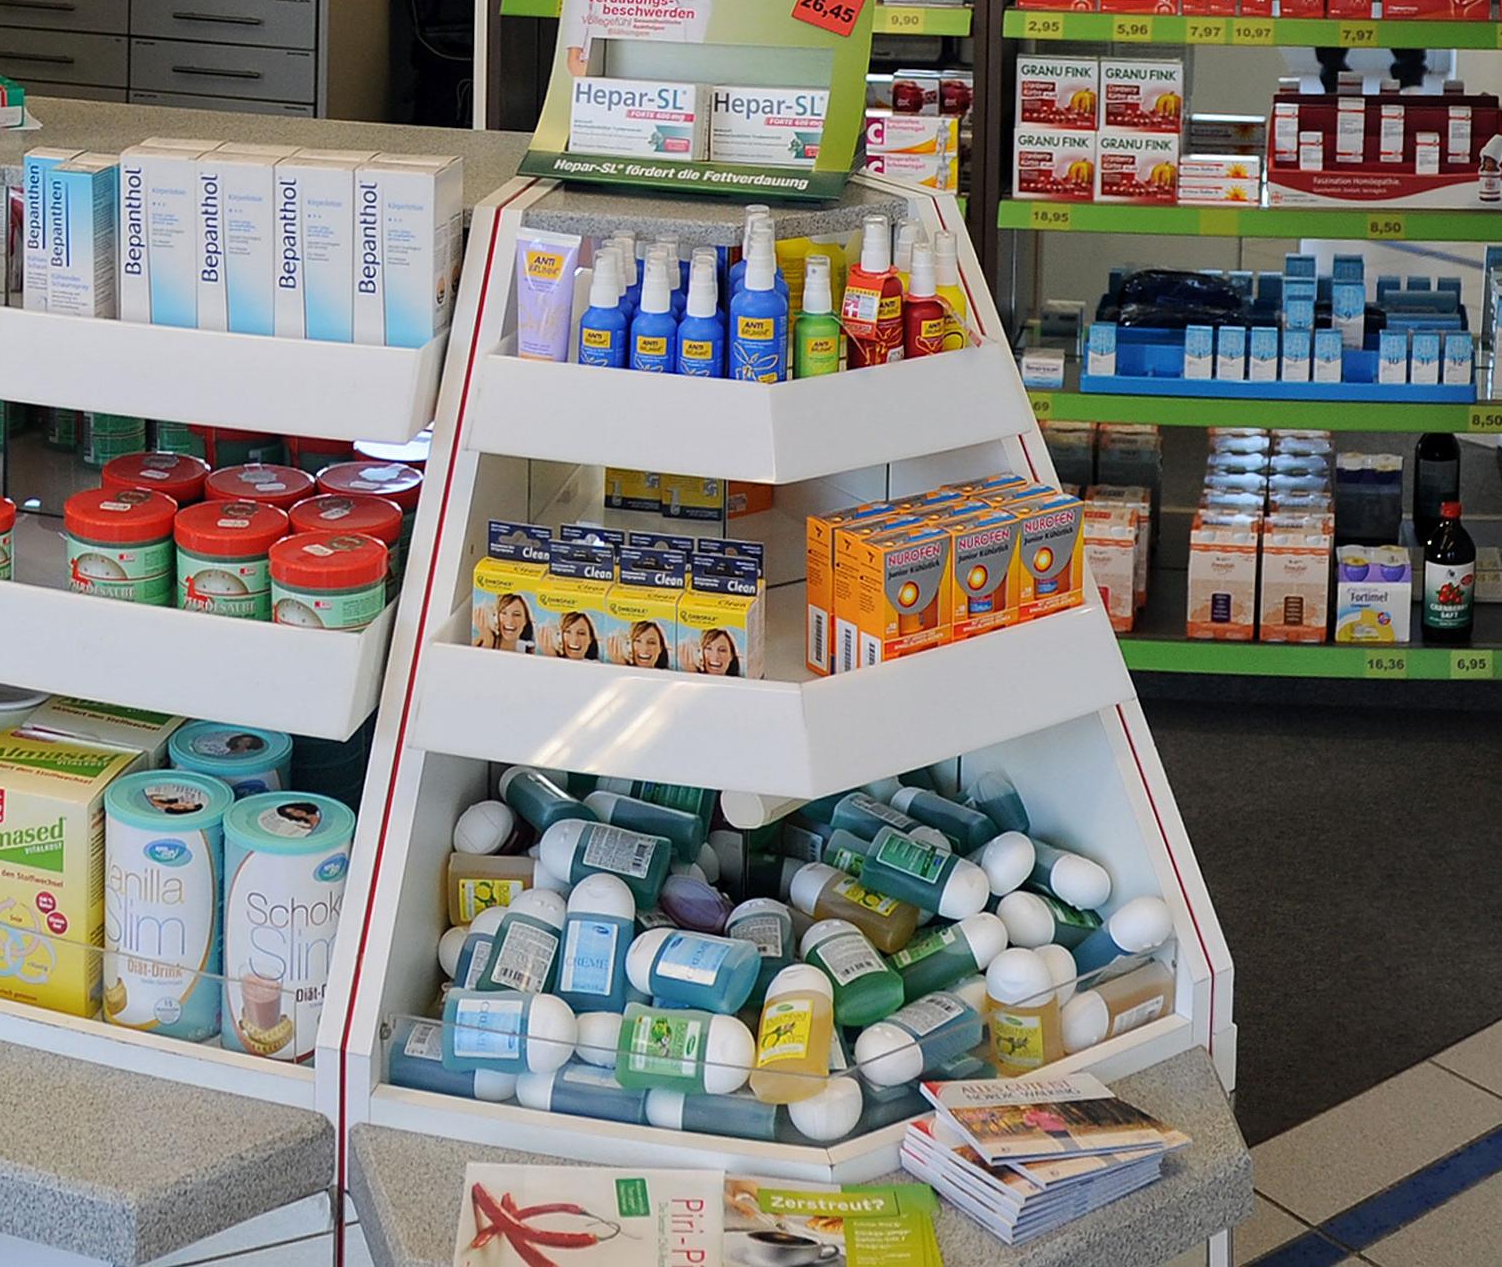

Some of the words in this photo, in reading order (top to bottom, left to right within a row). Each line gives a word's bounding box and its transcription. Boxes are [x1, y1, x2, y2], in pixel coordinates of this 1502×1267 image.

[603, 4, 695, 19] beschwerden
[1028, 20, 1060, 33] 2,95
[1117, 23, 1148, 36] 5,96
[1190, 26, 1220, 38] 7,97
[1235, 27, 1271, 38] 10,97
[1343, 29, 1374, 42] 7,97
[1021, 64, 1063, 77] GRANU
[1065, 66, 1092, 78] FINK
[1105, 67, 1147, 80] GRANU
[1149, 69, 1176, 81] FINK
[1018, 134, 1060, 147] GRANU
[1062, 136, 1089, 148] FINK
[1100, 137, 1143, 150] GRANU
[1145, 139, 1172, 151] FINK
[625, 164, 675, 179] fördert
[678, 168, 700, 180] die
[703, 172, 808, 189] Fettverdauung
[27, 163, 40, 250] Bepanthen
[51, 180, 63, 267] Bepanthen
[125, 167, 145, 275] Bepanthol
[1033, 212, 1069, 223] 18,95
[201, 173, 222, 283] Bepanthol
[278, 180, 300, 289] Bepanthol
[1370, 222, 1401, 234] 8,50
[1023, 510, 1074, 532] NUROFEN
[958, 528, 1010, 550] NUROFEN
[522, 546, 550, 561] Clean
[887, 543, 941, 566] NUROFEN
[583, 565, 613, 580] Clean
[654, 573, 684, 586] Clean
[727, 580, 756, 594] Clean
[1458, 659, 1487, 671] 6,95
[128, 959, 182, 977] Diät-Drink
[771, 1196, 884, 1211] Zerstreut?
